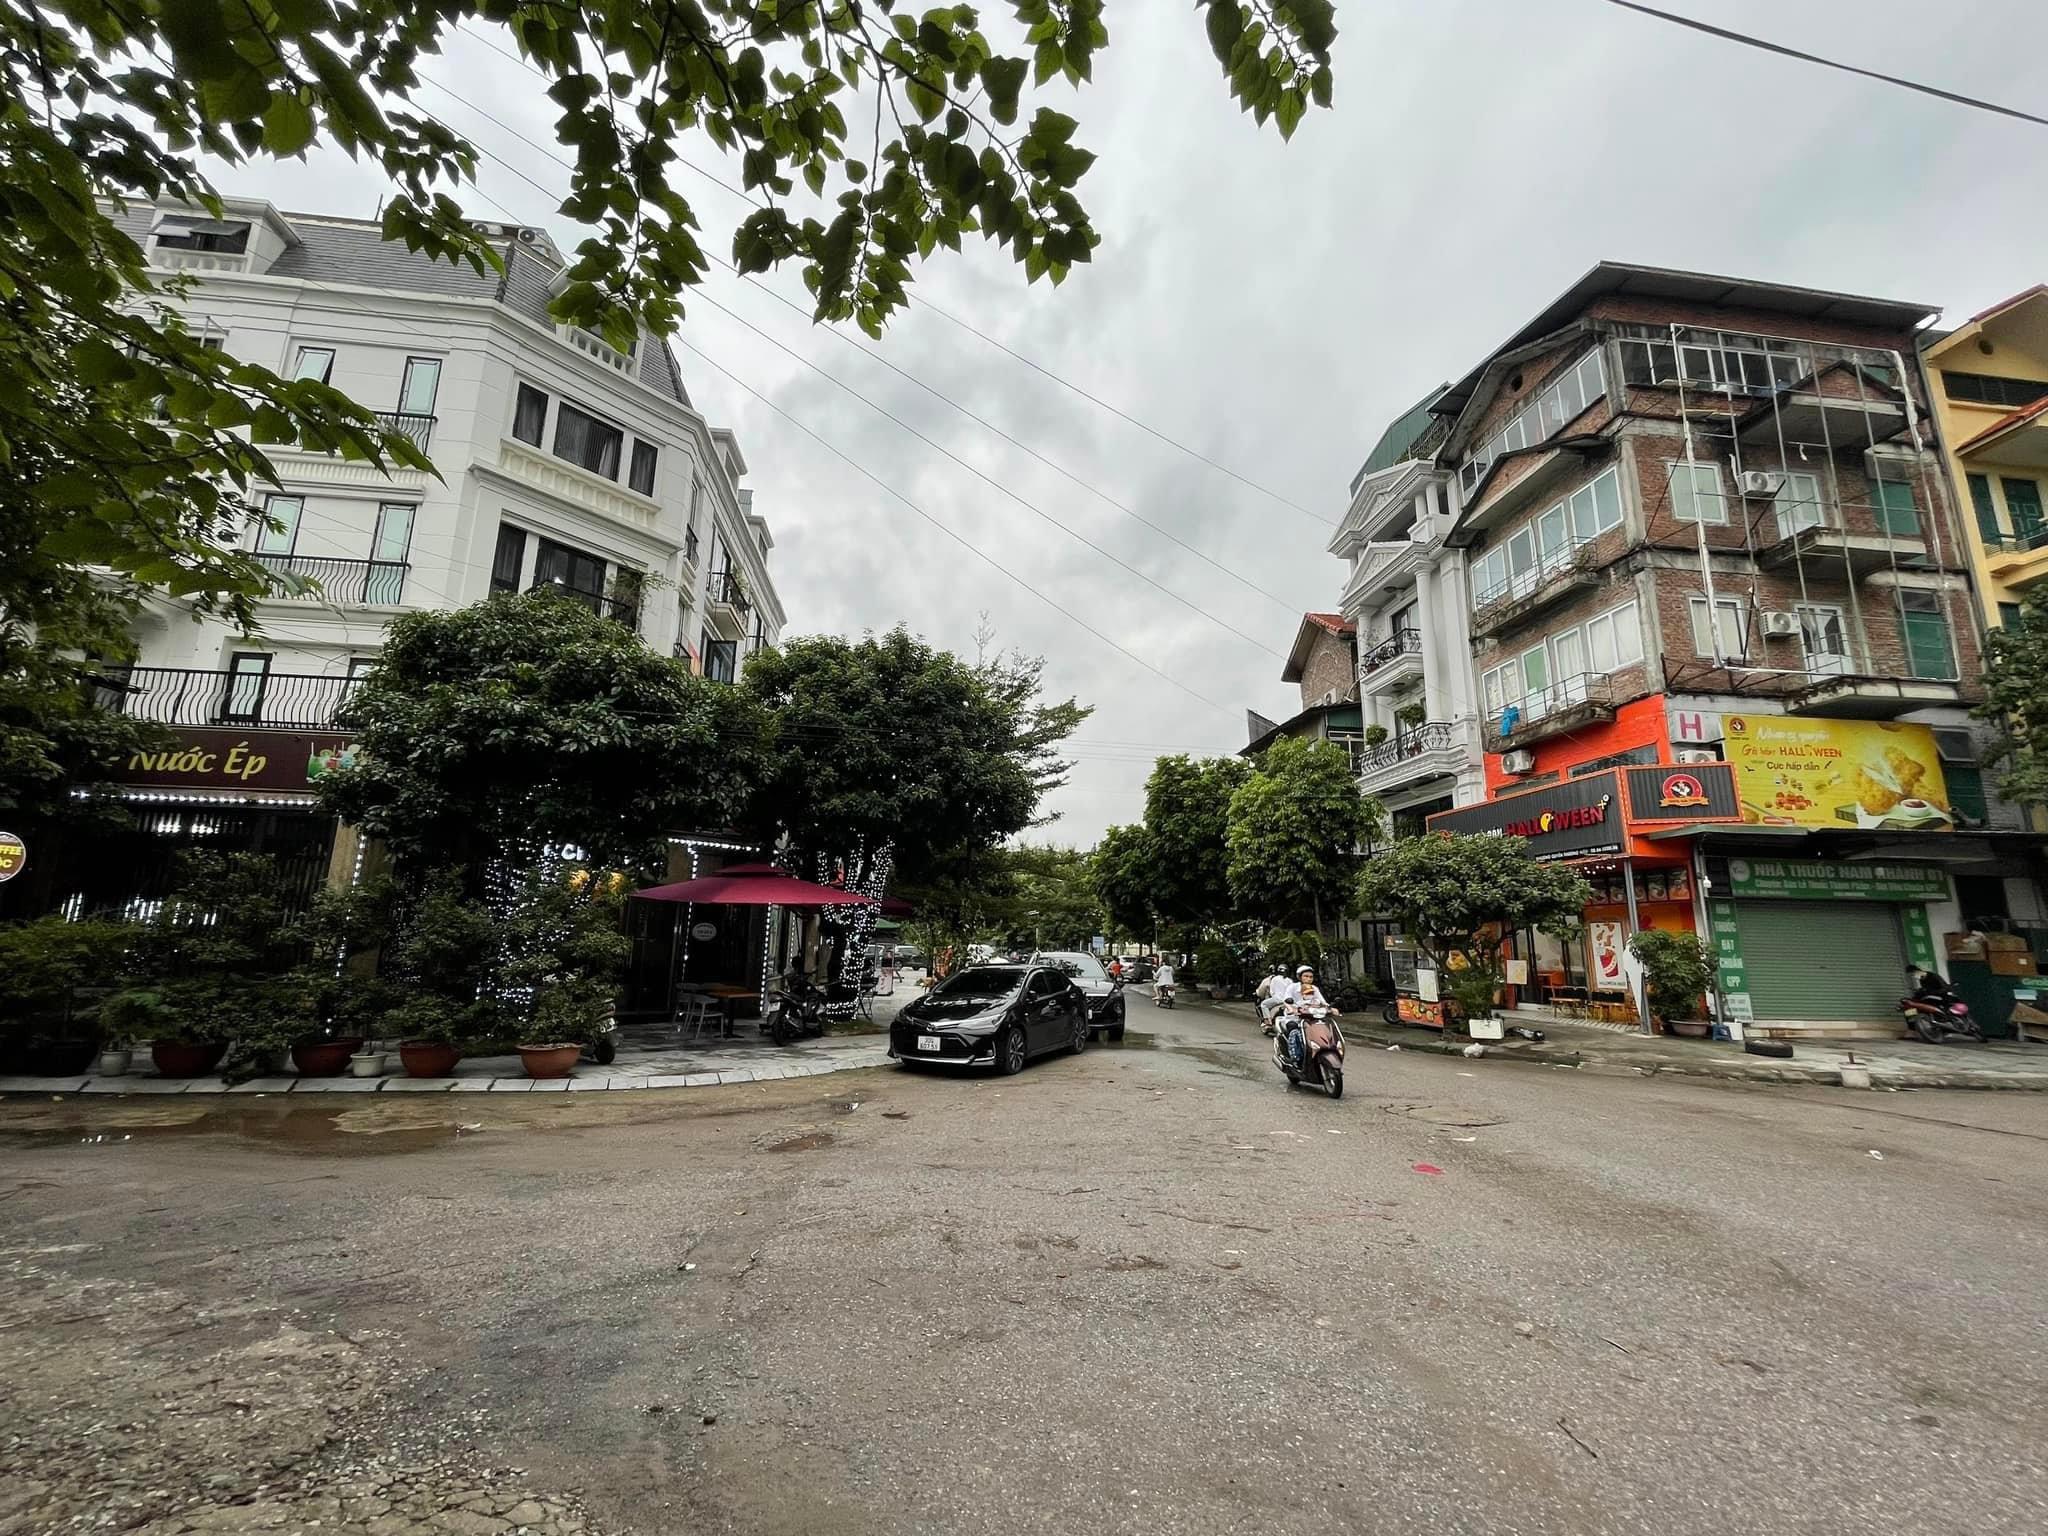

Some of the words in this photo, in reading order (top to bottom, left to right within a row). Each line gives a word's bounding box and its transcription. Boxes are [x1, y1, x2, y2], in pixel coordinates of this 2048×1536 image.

[1679, 712, 1703, 741] H
[128, 746, 218, 772] Nước
[223, 741, 267, 781] Ép
[1754, 862, 1785, 877] NHÀ
[1789, 861, 1836, 879] THUỐC
